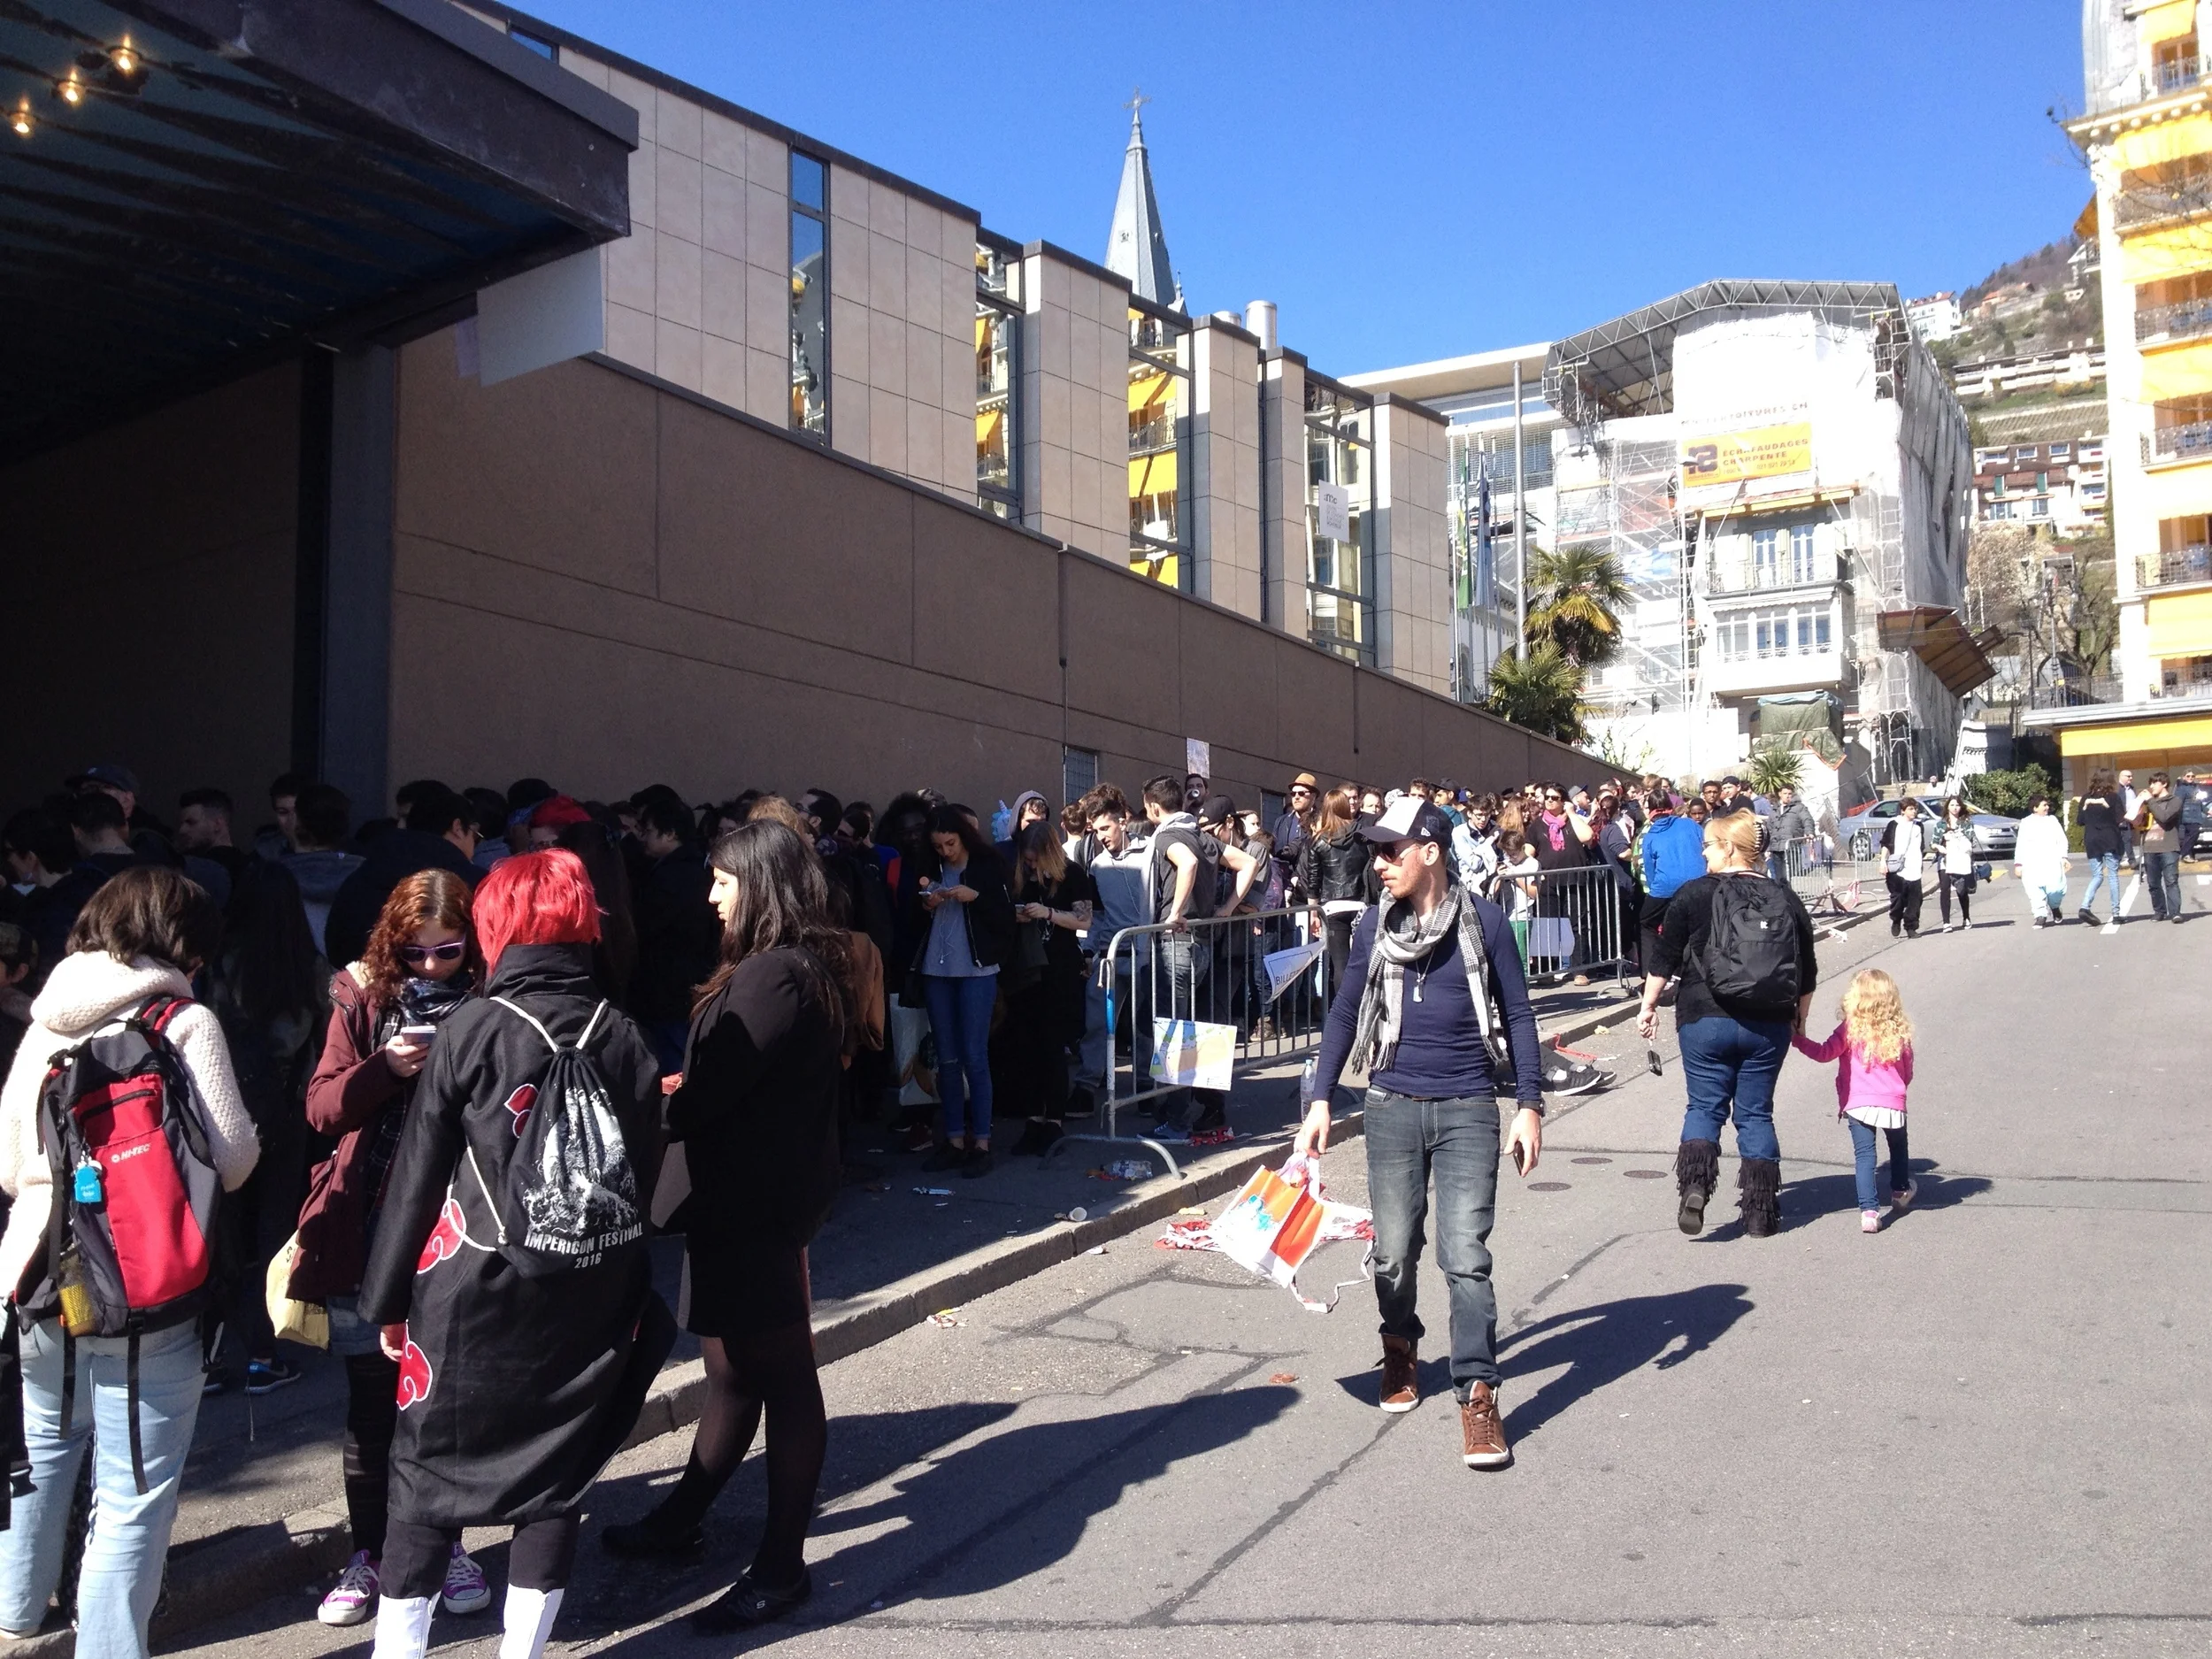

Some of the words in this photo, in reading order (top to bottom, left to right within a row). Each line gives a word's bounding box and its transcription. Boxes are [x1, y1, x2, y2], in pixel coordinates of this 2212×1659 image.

[1723, 438, 1809, 457] ÉCHFAUDAGES
[524, 1230, 595, 1255] IMPERICON
[598, 1221, 643, 1251] FESTIVAL
[573, 1253, 602, 1269] 2016
